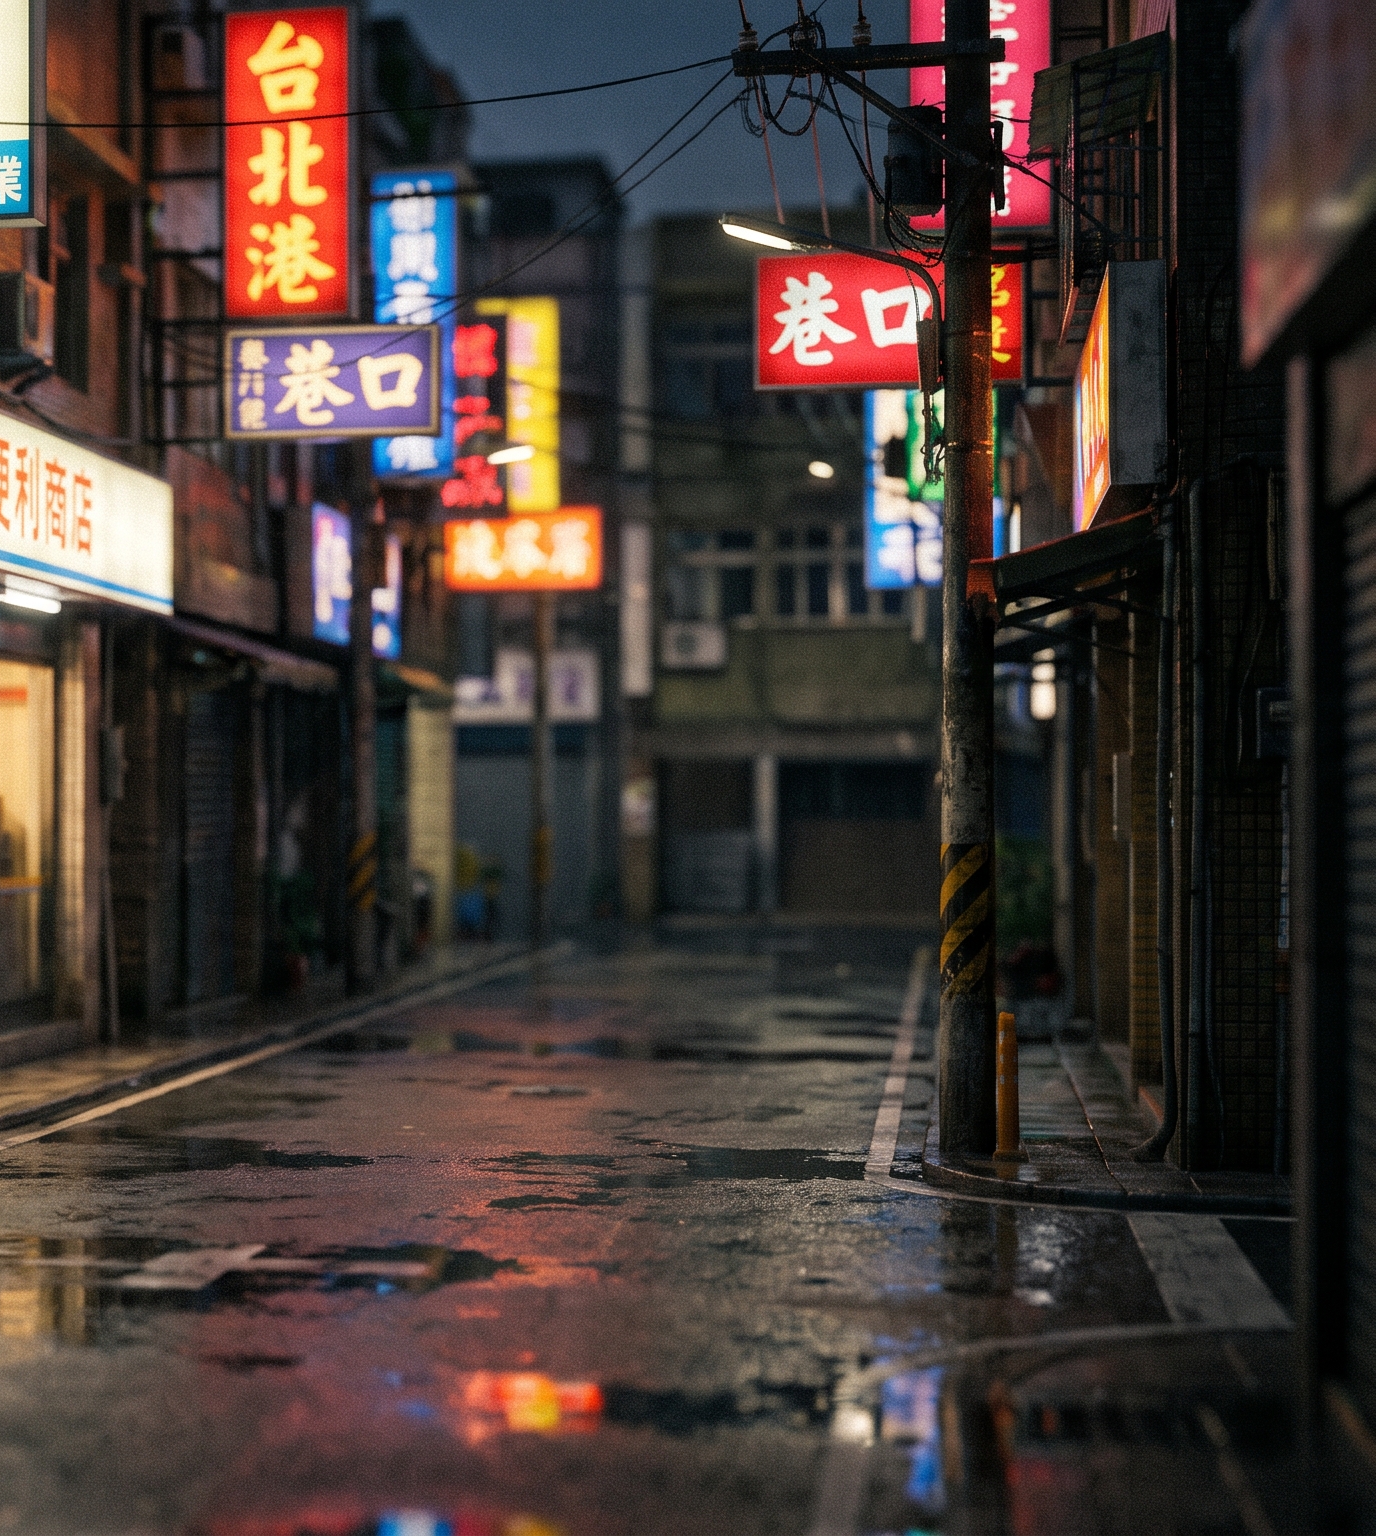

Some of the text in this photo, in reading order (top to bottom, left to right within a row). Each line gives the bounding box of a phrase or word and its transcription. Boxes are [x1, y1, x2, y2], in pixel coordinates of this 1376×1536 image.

[244, 20, 336, 304] 台北港
[768, 271, 932, 366] 巷口
[274, 339, 423, 426] 巷口
